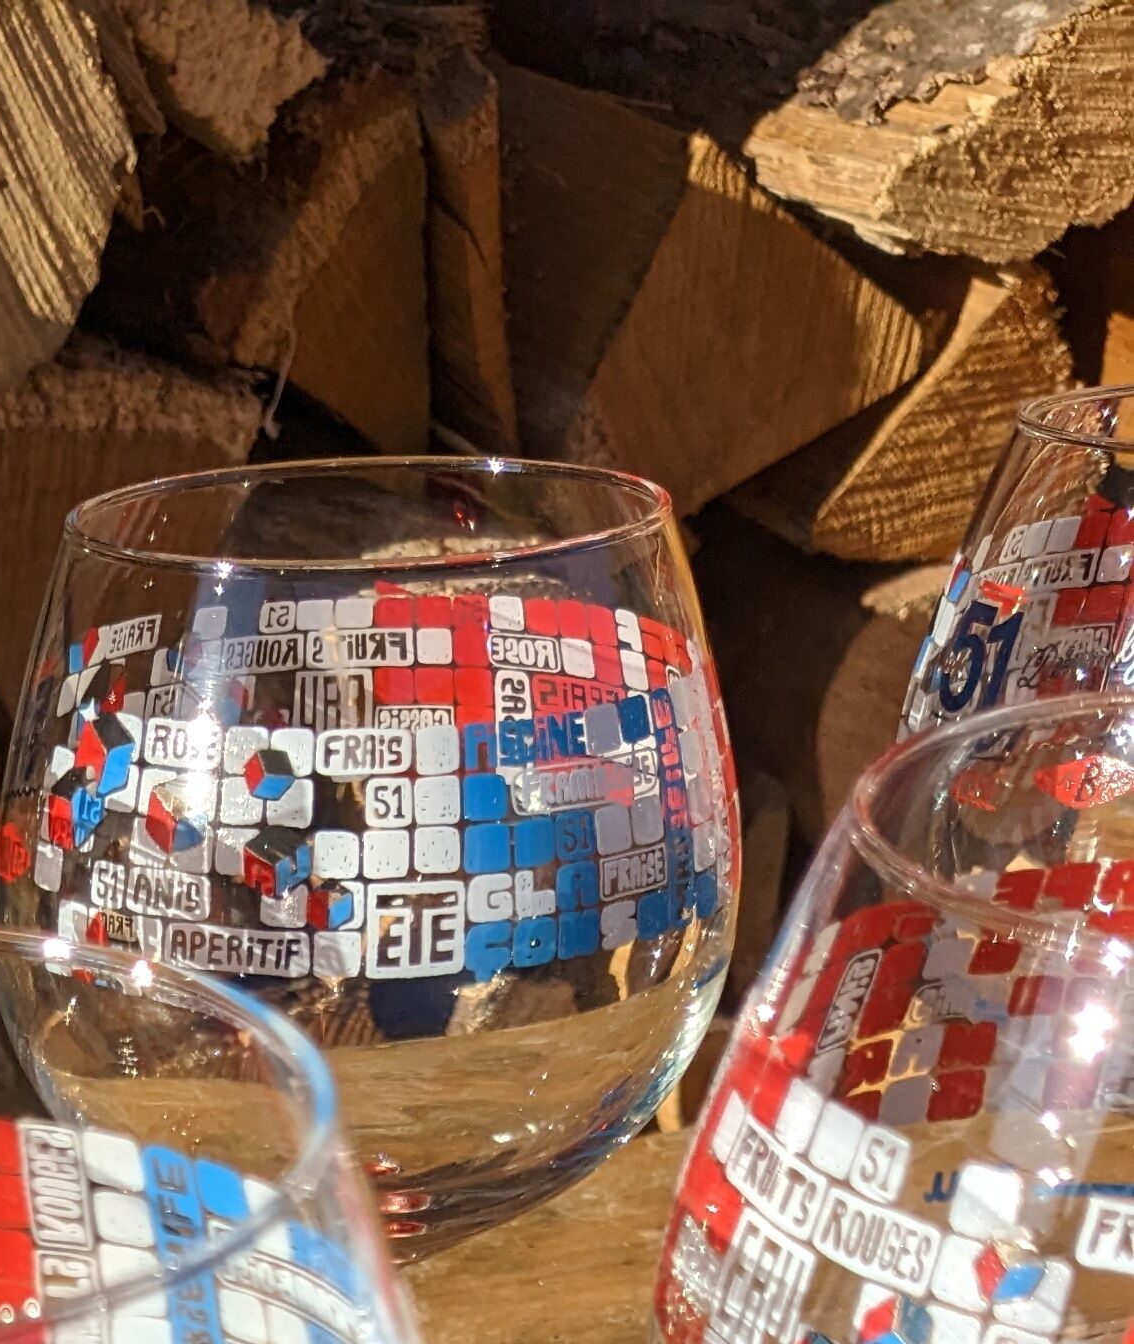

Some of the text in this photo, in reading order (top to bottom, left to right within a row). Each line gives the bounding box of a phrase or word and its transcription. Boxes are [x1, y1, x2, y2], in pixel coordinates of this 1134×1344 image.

[939, 600, 1024, 713] 51
[373, 785, 405, 817] 51
[562, 824, 594, 851] 51
[857, 1138, 899, 1191] 51
[819, 1203, 926, 1283] ROUGES
